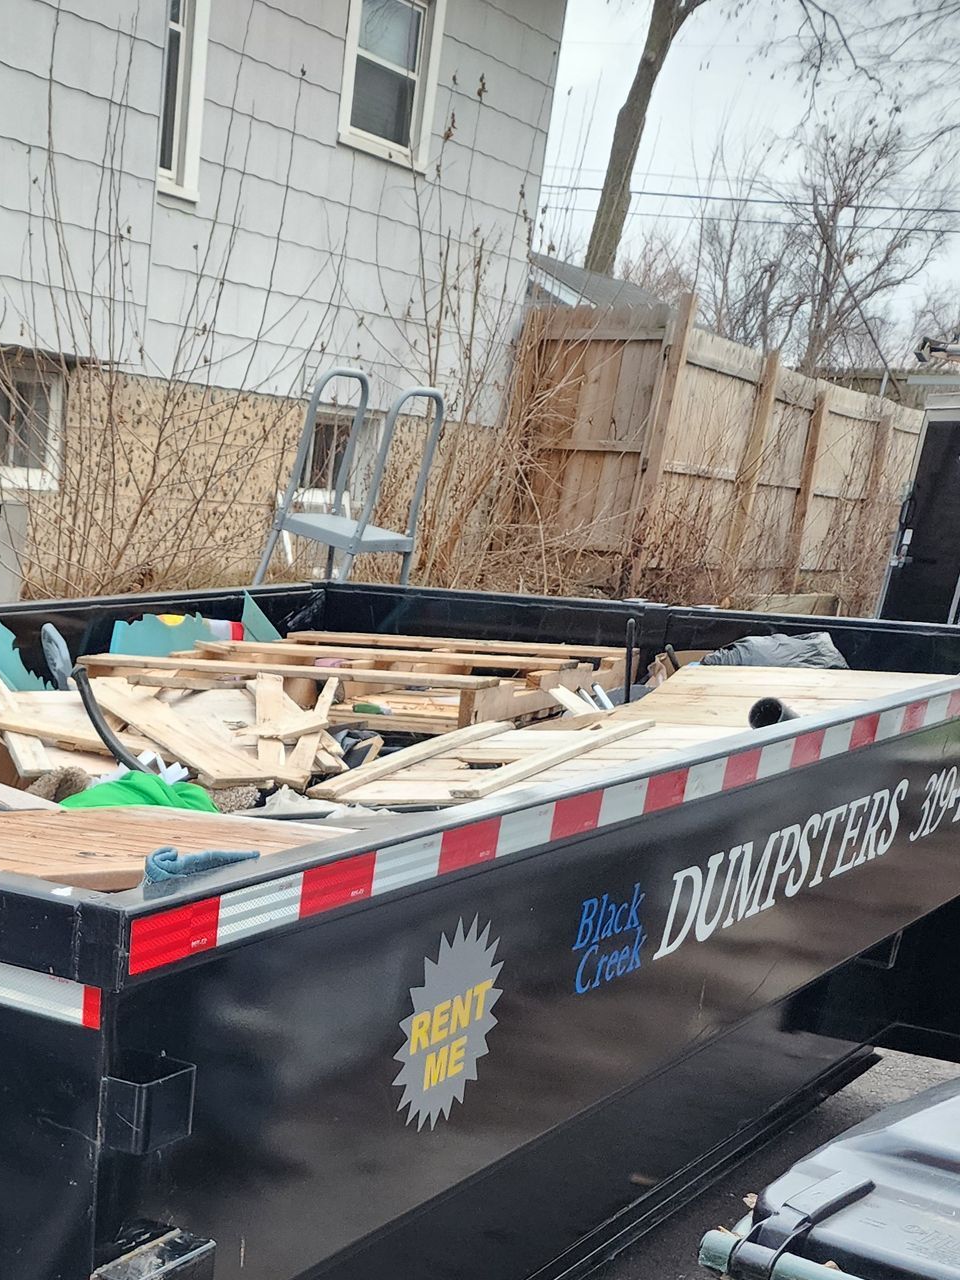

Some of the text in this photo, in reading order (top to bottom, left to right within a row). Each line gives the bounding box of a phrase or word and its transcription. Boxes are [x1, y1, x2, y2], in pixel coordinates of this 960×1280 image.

[653, 778, 909, 961] DUMPSTERS
[572, 884, 646, 952] Black
[575, 928, 647, 995] Creek
[410, 979, 493, 1055] RENT
[423, 1037, 467, 1092] ME
